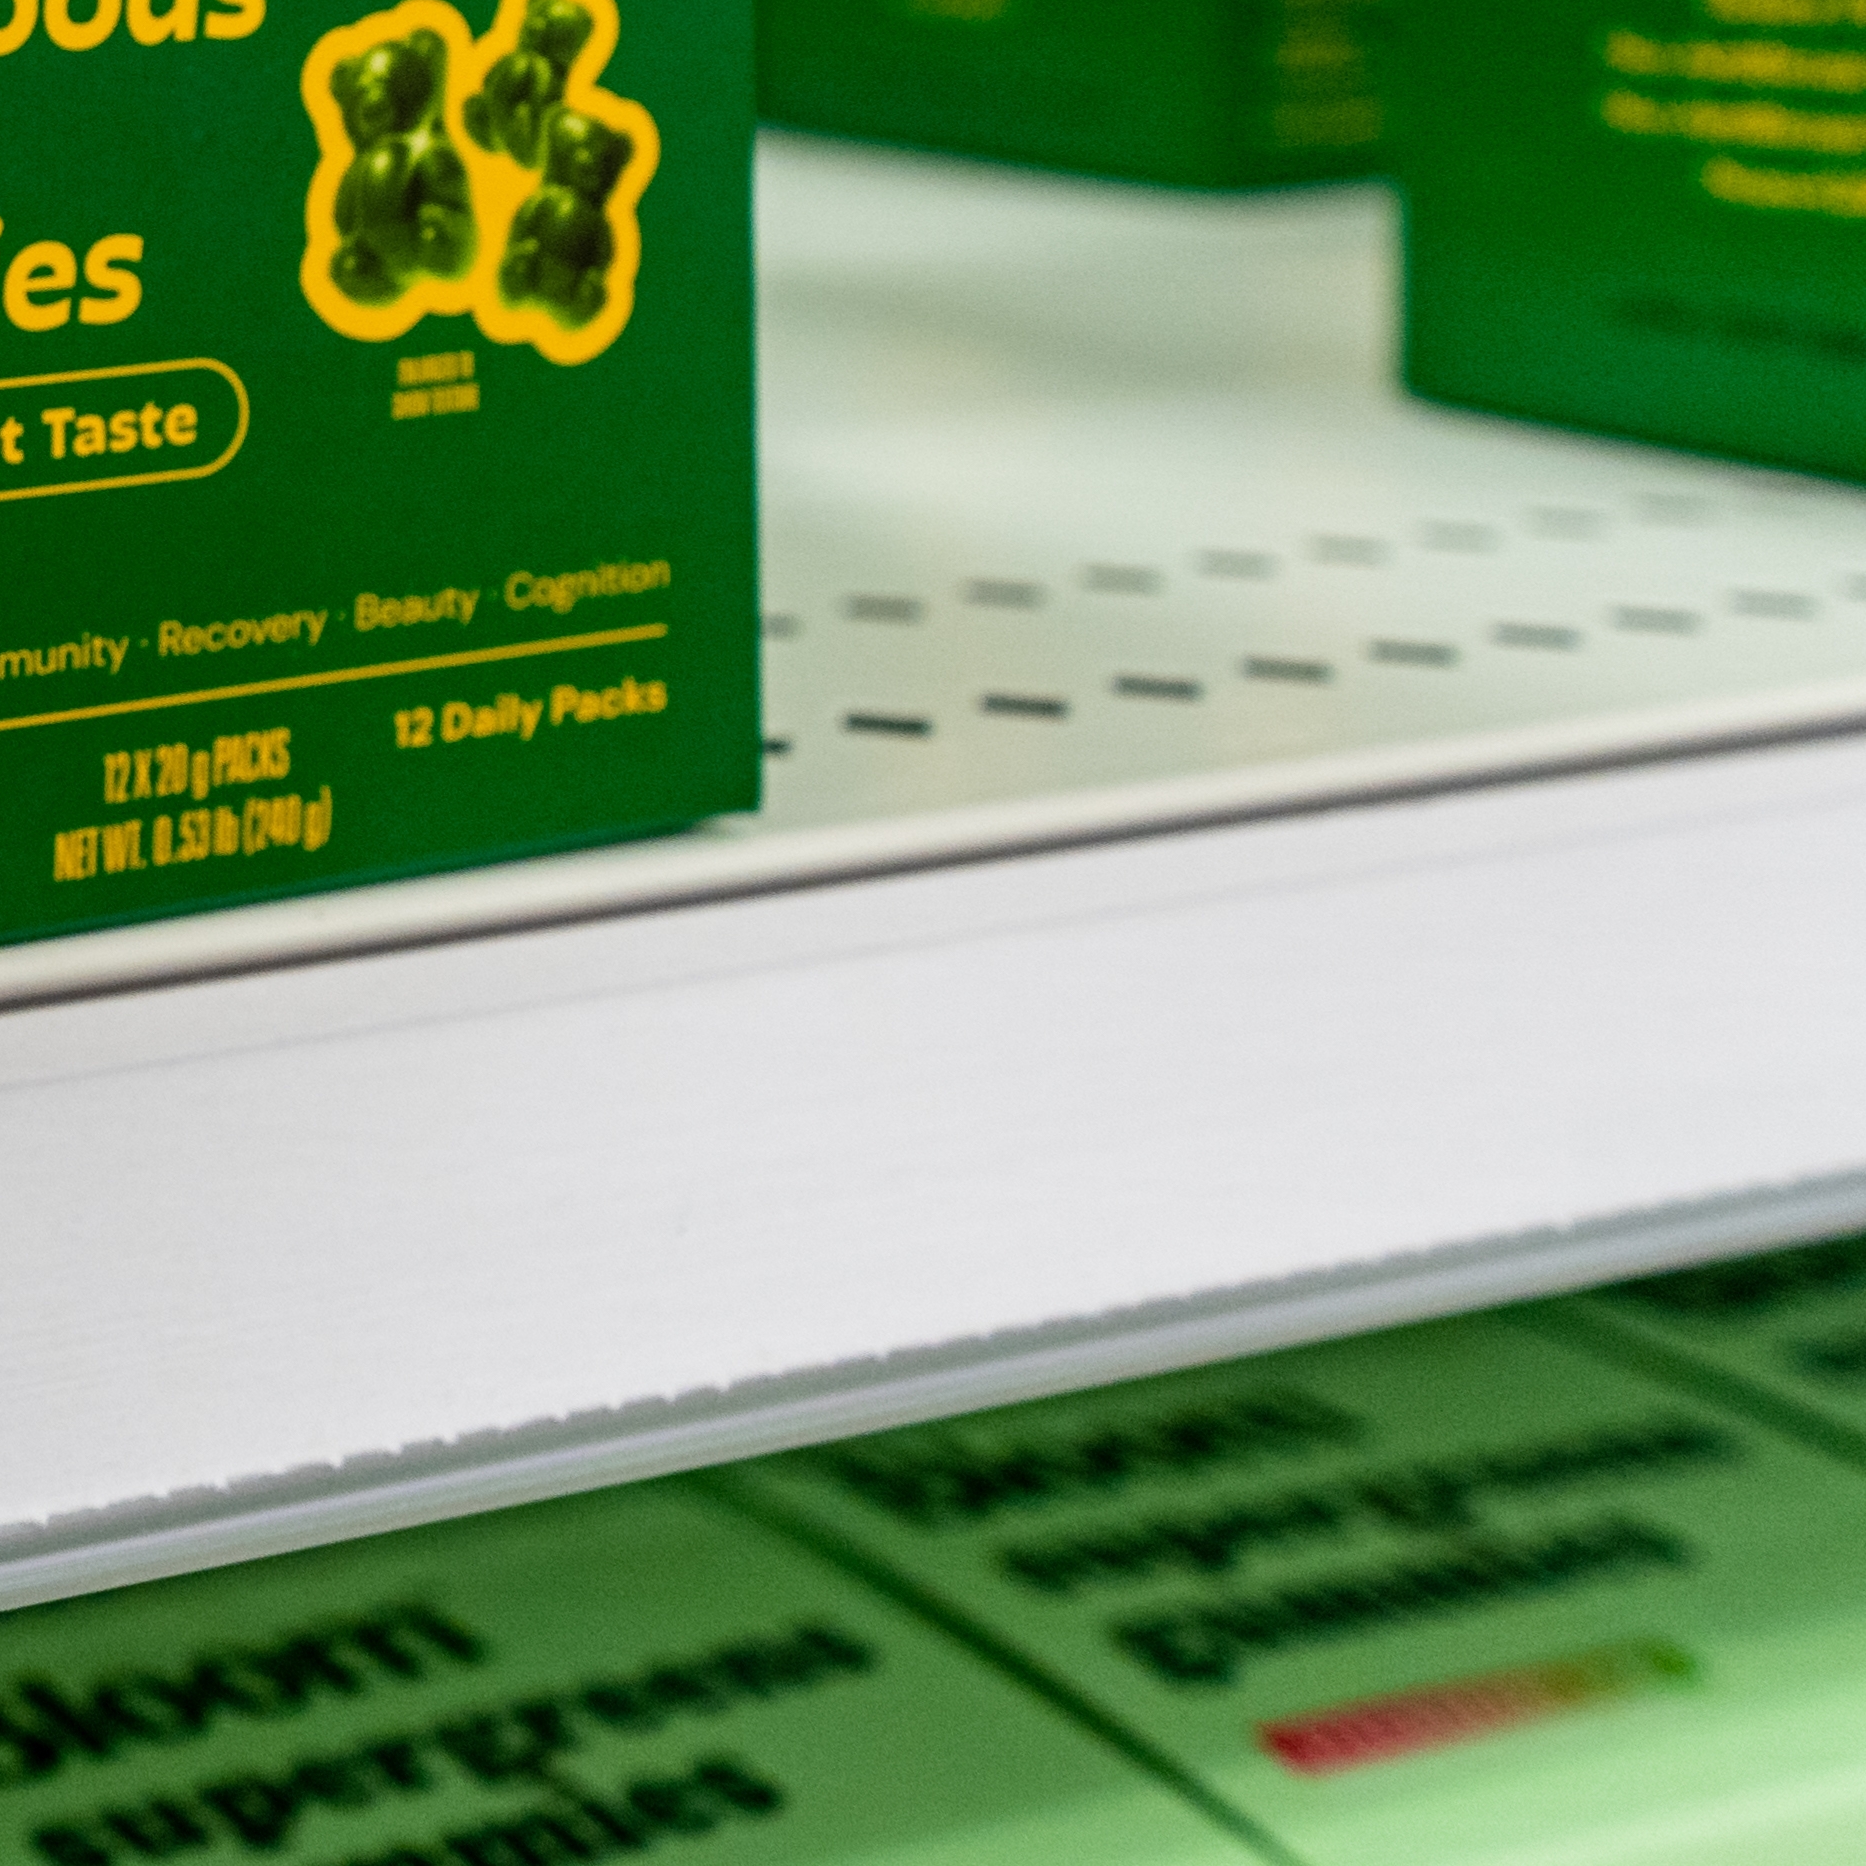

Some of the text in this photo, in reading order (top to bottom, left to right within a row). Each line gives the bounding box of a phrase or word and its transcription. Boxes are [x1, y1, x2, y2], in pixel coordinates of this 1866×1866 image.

[41, 402, 197, 459] Taste
[159, 612, 326, 655] Recovery
[356, 589, 478, 630] Beauty
[507, 562, 669, 611] Cognition
[395, 679, 667, 747] 12 Daily Packs
[105, 728, 290, 802] 12 X 20 g PACKS
[54, 827, 100, 880] NET
[213, 807, 239, 854] lb
